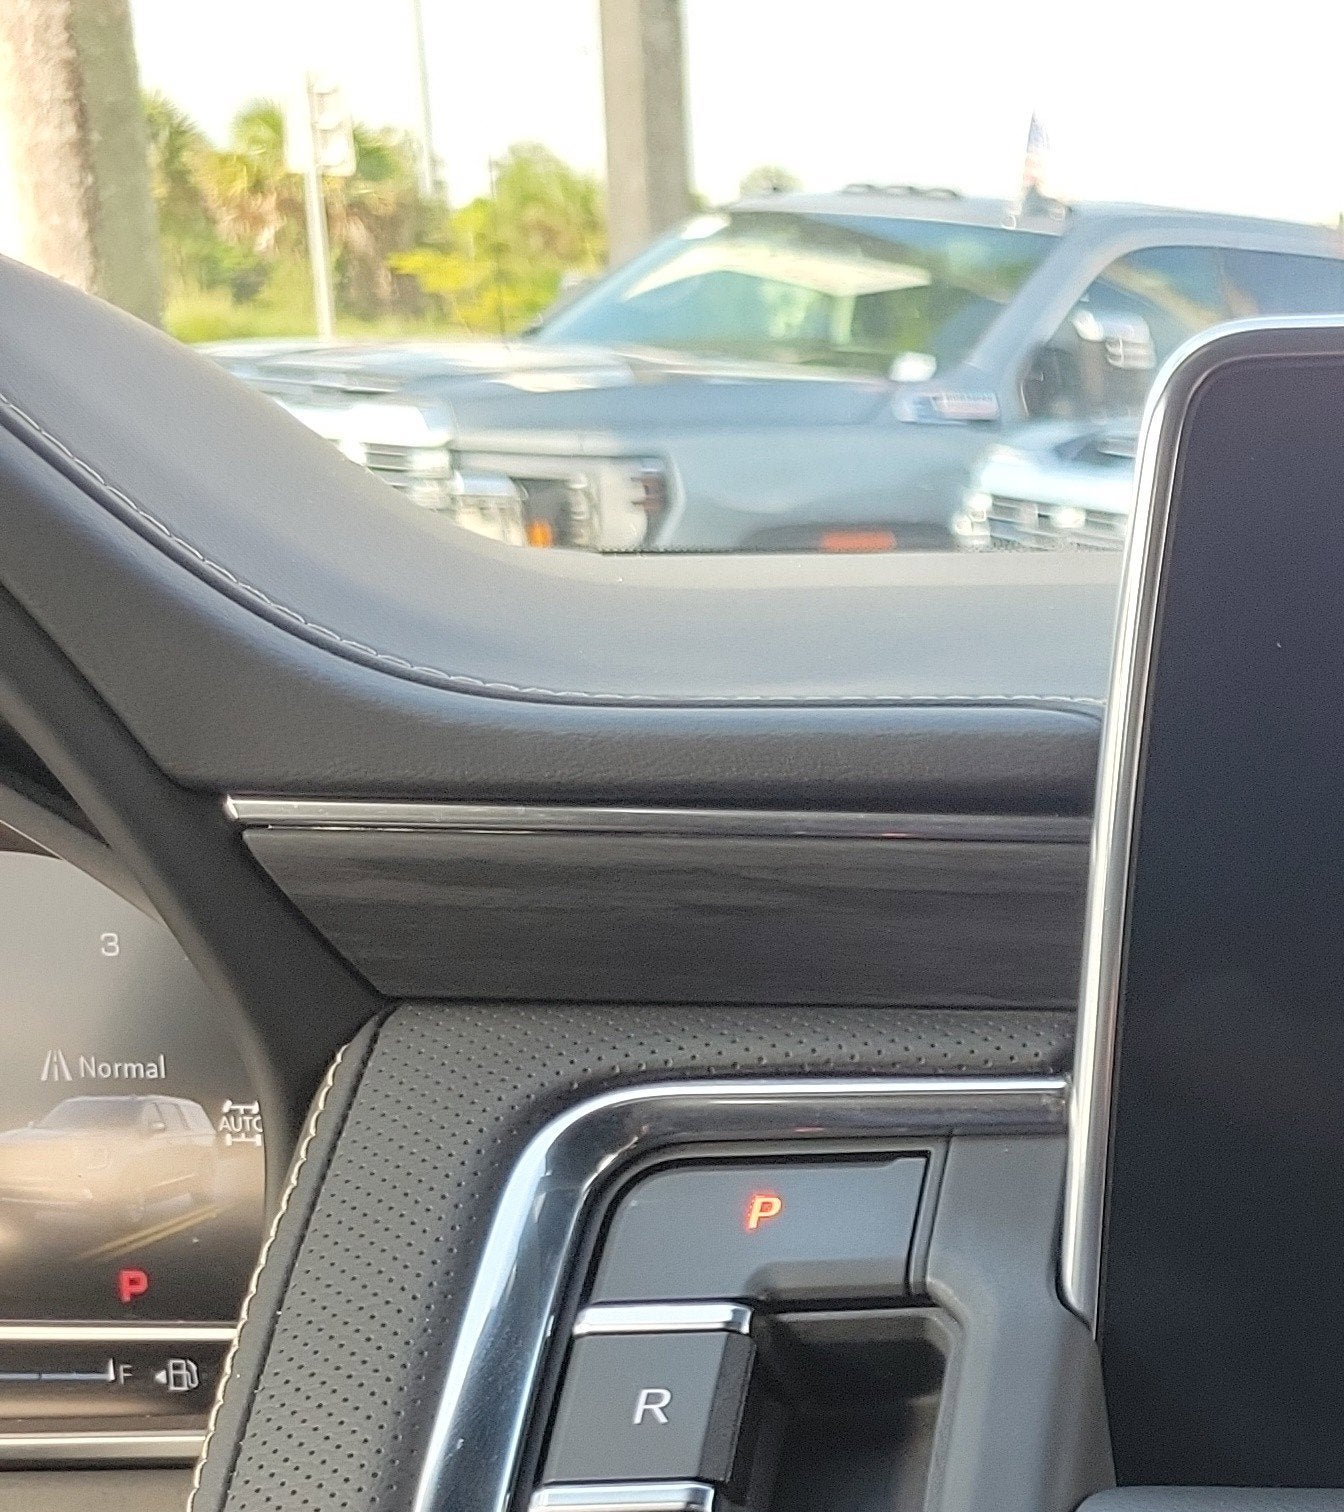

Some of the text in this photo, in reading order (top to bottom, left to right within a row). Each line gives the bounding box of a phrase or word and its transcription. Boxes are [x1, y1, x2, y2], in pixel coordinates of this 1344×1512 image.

[100, 932, 120, 957] 3
[78, 1053, 167, 1081] Normal
[744, 1192, 783, 1231] P
[118, 1267, 149, 1303] P
[118, 1363, 134, 1386] F
[632, 1387, 672, 1425] R
